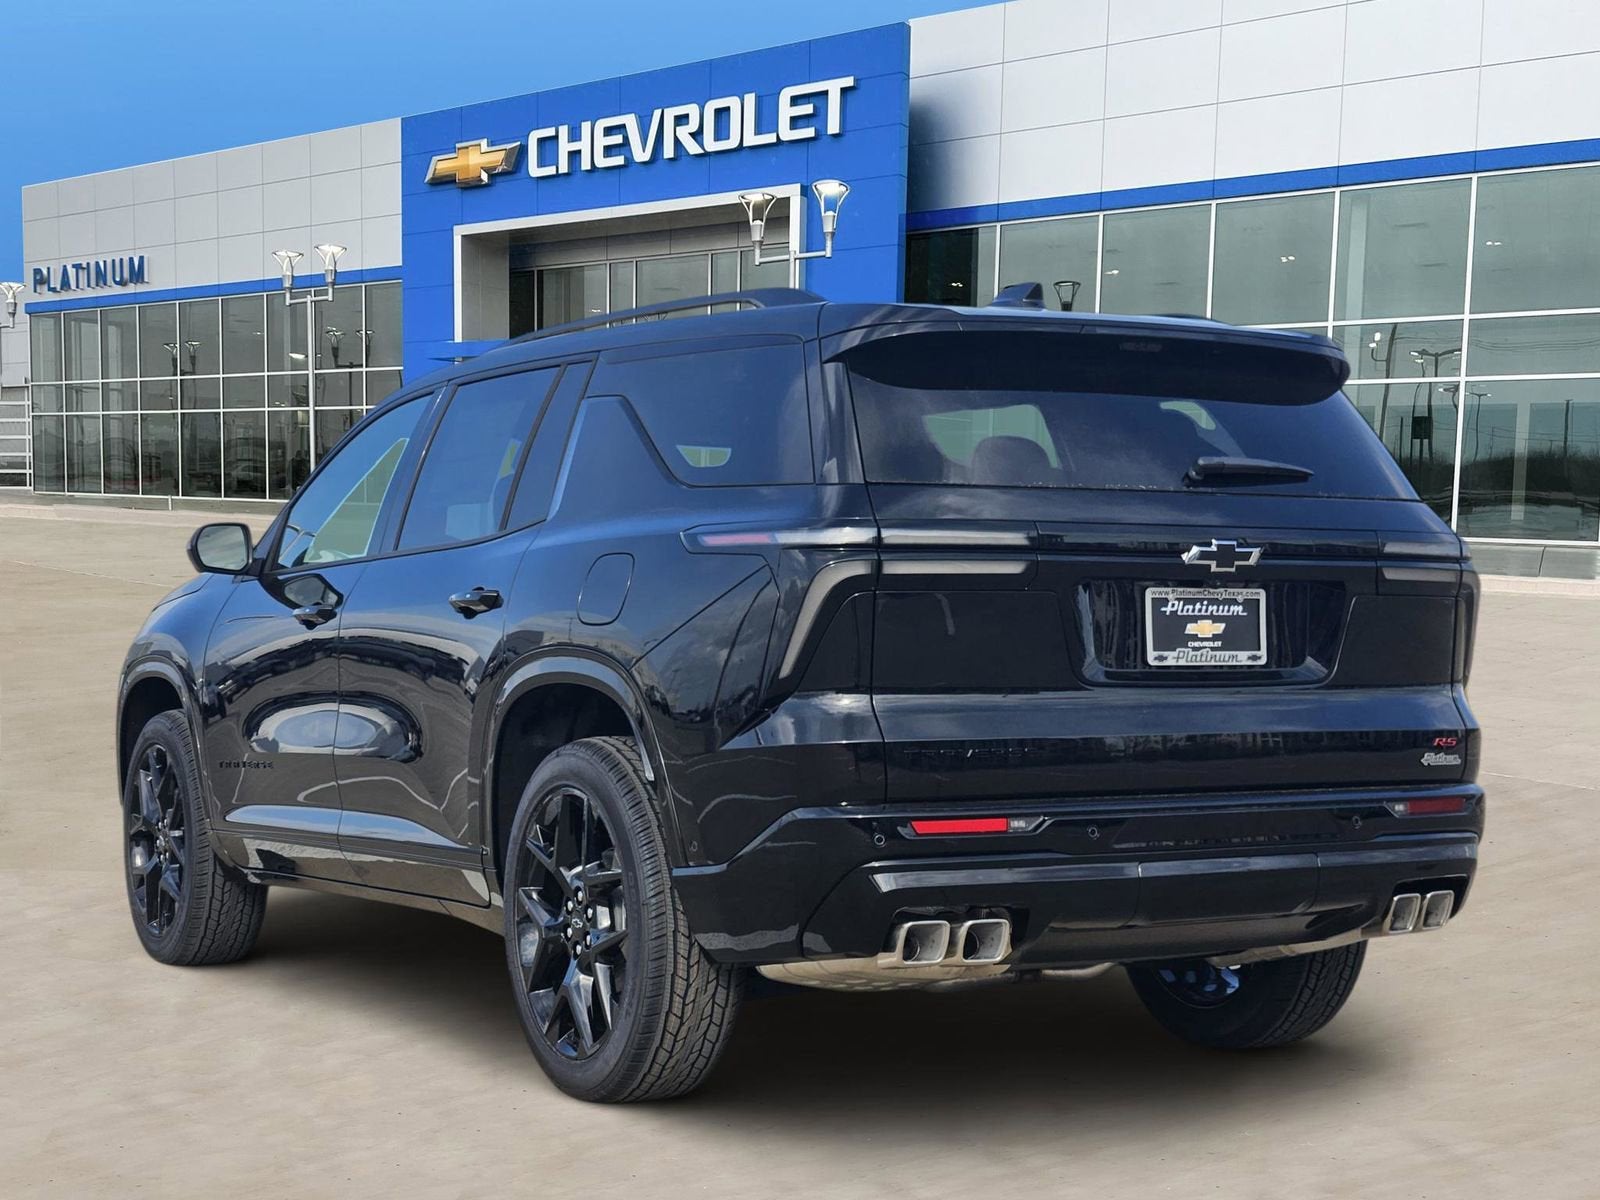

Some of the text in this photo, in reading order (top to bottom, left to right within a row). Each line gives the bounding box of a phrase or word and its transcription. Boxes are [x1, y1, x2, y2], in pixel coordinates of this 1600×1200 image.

[527, 76, 855, 178] CHEVROLET
[33, 255, 147, 294] PLATINUM
[1150, 589, 1261, 598] www.PlatinumChevyTexas.com
[1160, 601, 1248, 616] Platinum
[1172, 650, 1243, 664] Platinum
[1433, 737, 1457, 746] RS
